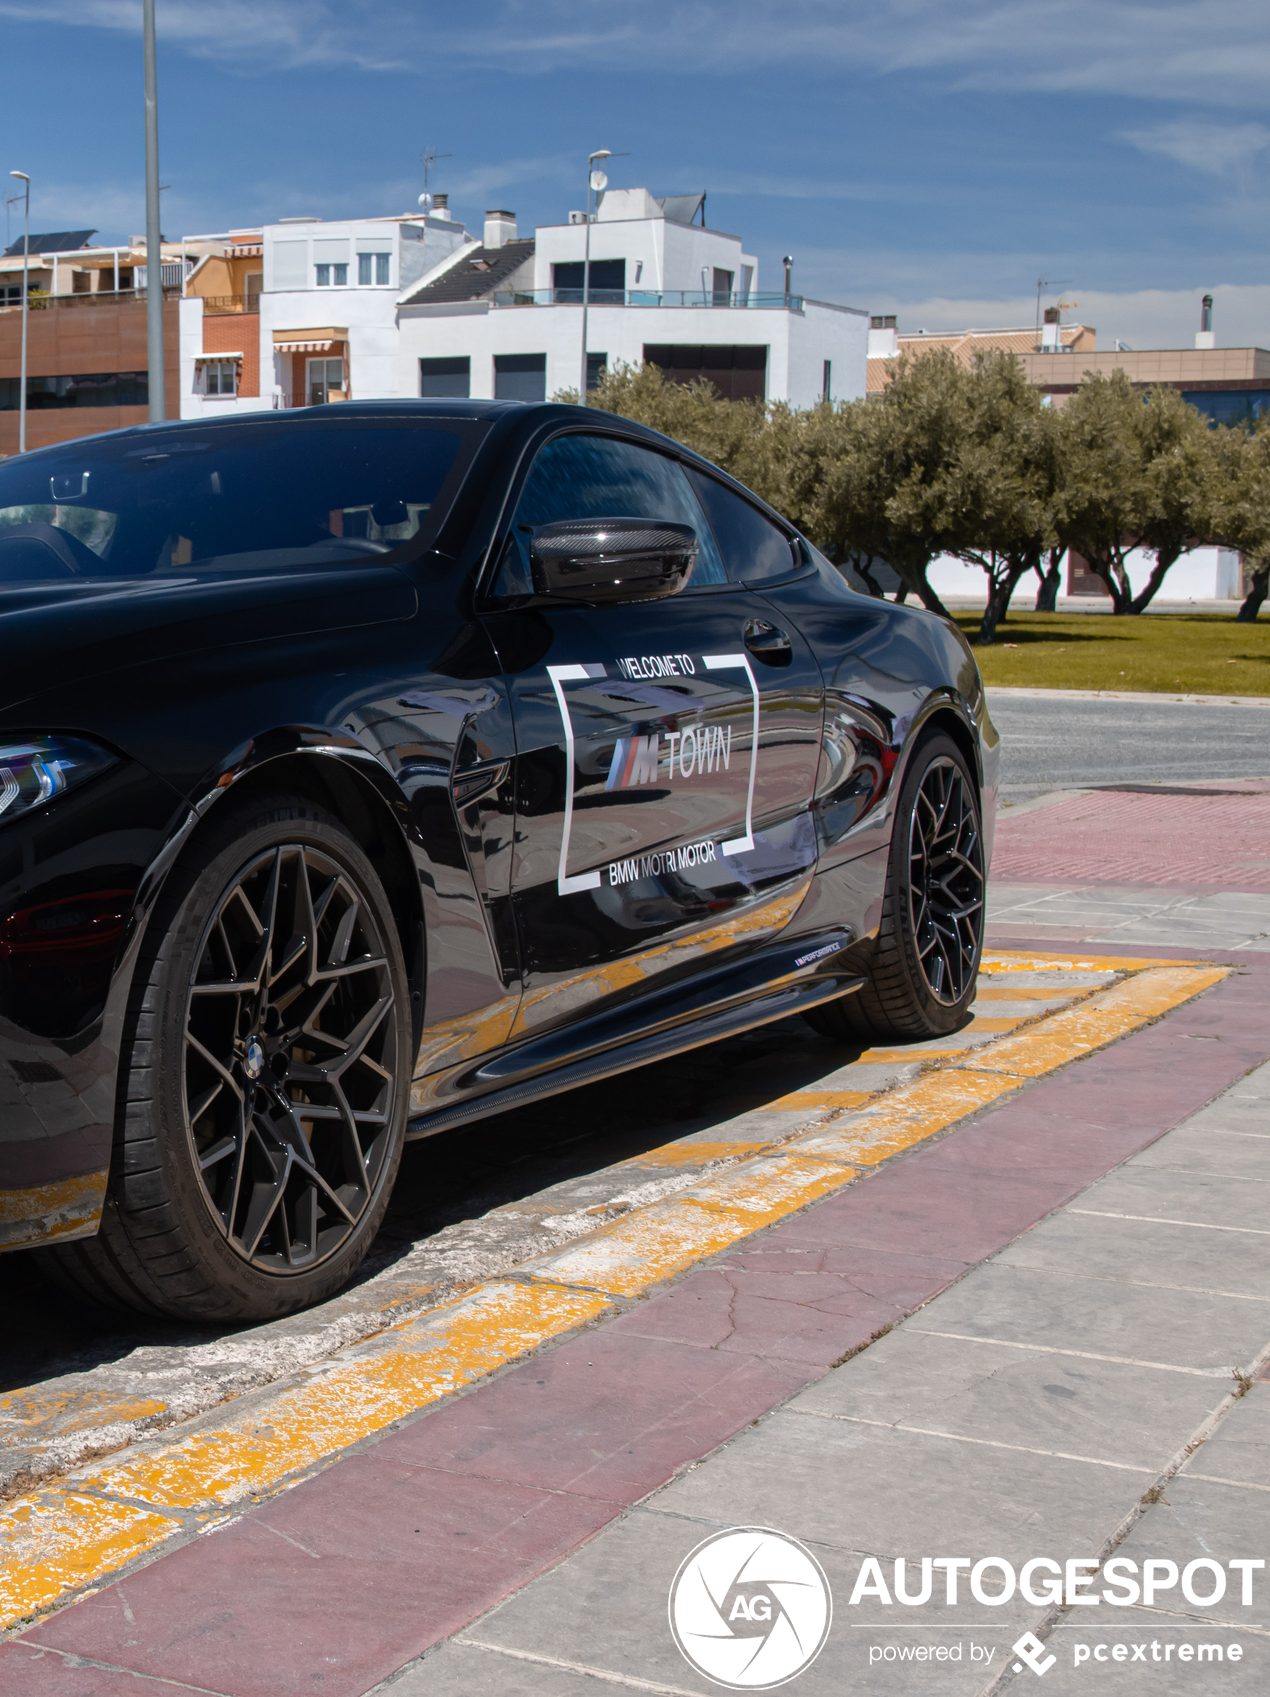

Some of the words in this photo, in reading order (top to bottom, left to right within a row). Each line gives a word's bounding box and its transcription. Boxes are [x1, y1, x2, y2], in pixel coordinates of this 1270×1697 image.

[615, 655, 674, 680] WELCOME
[674, 653, 696, 675] TO
[664, 725, 732, 780] TOWN
[609, 857, 640, 886] BMW
[640, 848, 678, 878] MOTRI
[677, 840, 717, 869] MOTOR
[802, 941, 841, 964] PERFORMANCE
